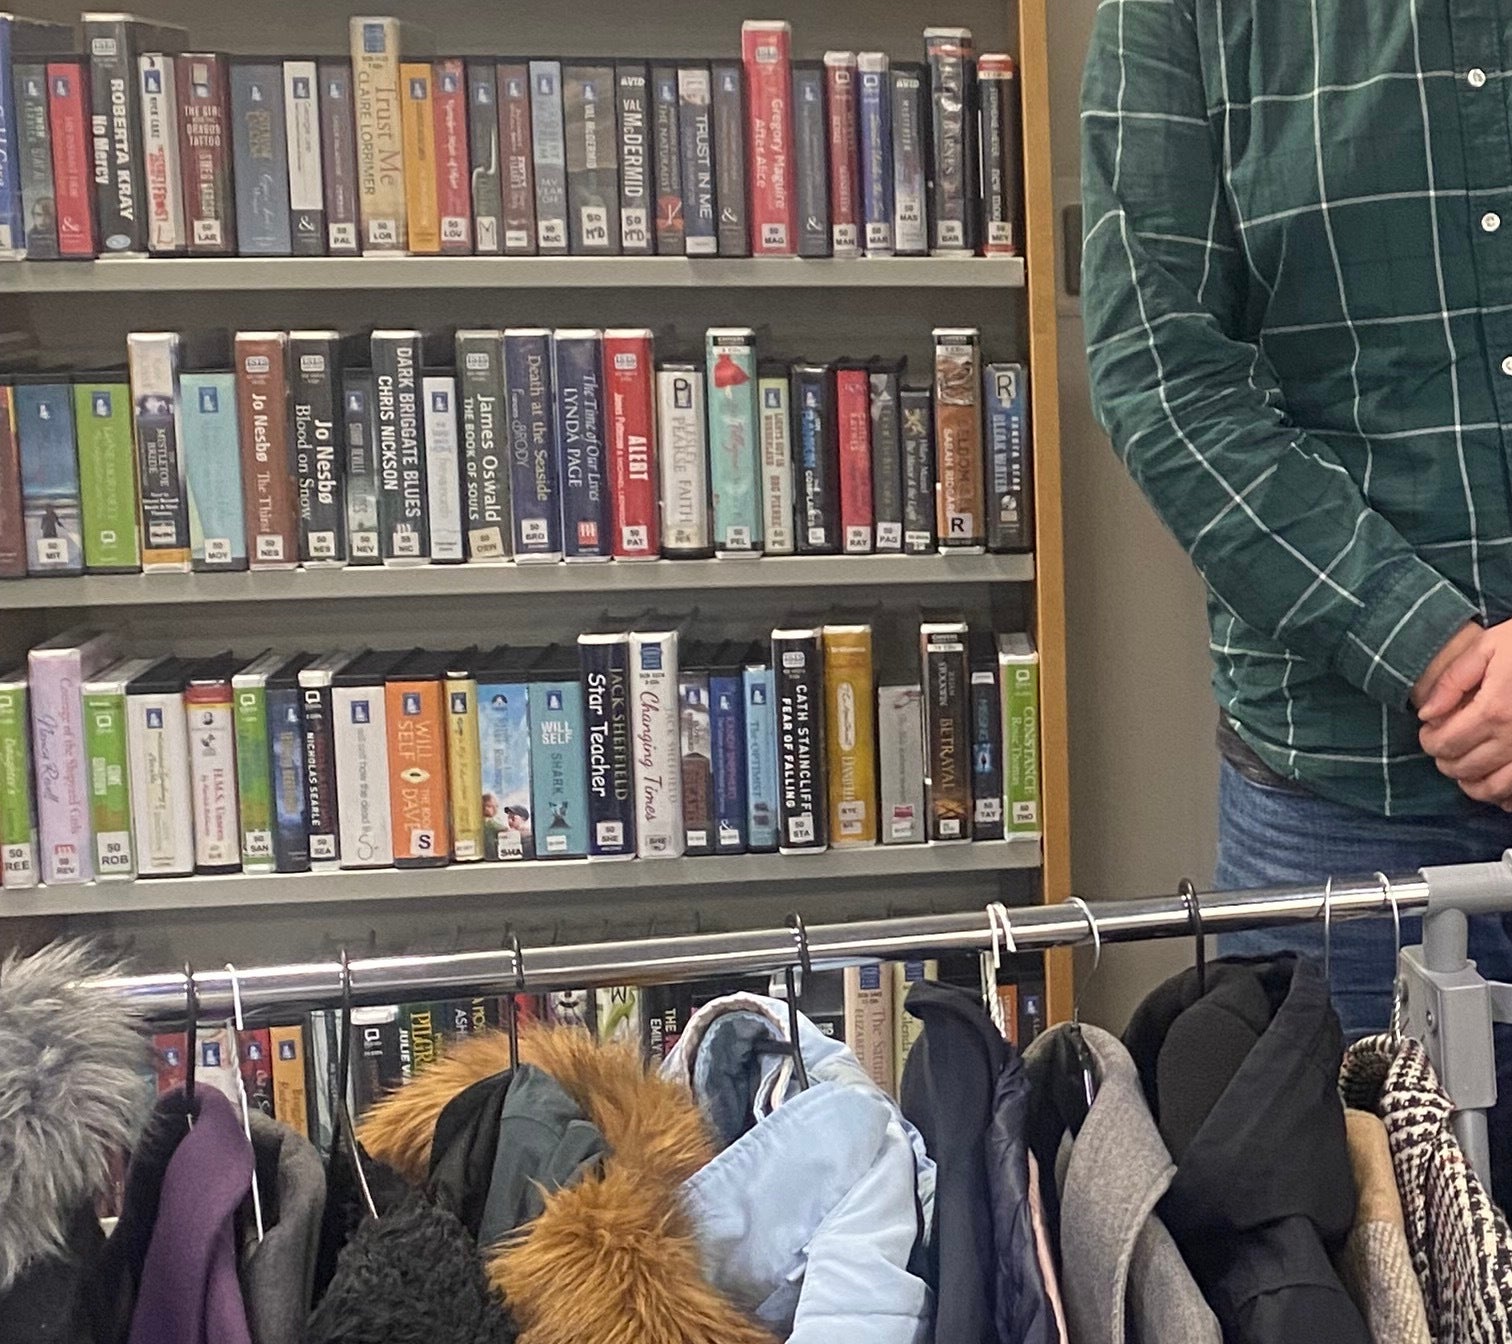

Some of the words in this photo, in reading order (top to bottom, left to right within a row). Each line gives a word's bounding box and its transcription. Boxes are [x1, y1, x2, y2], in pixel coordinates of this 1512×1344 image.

[357, 71, 372, 125] CLAIRE
[374, 82, 397, 139] Trust
[622, 98, 642, 112] VAL
[659, 104, 669, 124] THE
[91, 115, 107, 136] No
[110, 78, 130, 164] ROBERTA
[189, 135, 221, 147] TATTOO
[695, 113, 710, 167] TRUST
[771, 98, 784, 154] Gregory
[94, 137, 110, 185] Mercy
[360, 126, 377, 197] LORRIMER
[377, 149, 401, 187] Me
[622, 112, 644, 198] McDERMID
[116, 170, 134, 221] KRAY
[697, 172, 711, 189] IN
[773, 155, 786, 210] Maguire
[698, 193, 713, 219] ME
[396, 347, 414, 389] DARK
[527, 355, 545, 397] Death
[583, 373, 596, 396] The
[996, 375, 1012, 397] R
[252, 393, 267, 411] Jo
[377, 375, 394, 421] CHRIS
[463, 396, 474, 421] THE
[530, 401, 542, 418] at
[562, 388, 581, 444] LYNDA
[583, 399, 598, 431] Time
[253, 415, 269, 463] Nesbø
[295, 404, 312, 454] Blood
[314, 419, 332, 440] Jo
[399, 393, 418, 466] BRIGGATE
[476, 393, 495, 449] James
[532, 422, 546, 444] the
[992, 413, 1006, 452] BLEAK
[147, 442, 158, 474] BRIDE
[156, 427, 170, 487] MISTLETOE
[380, 425, 399, 491] NICKSON
[463, 425, 475, 458] BOOK
[511, 419, 530, 469] BRODY
[585, 445, 600, 471] Our
[627, 435, 649, 481] ALERT
[671, 416, 687, 472] PEARSE
[942, 428, 954, 467] SARAH
[257, 470, 271, 493] The
[298, 455, 308, 474] on
[316, 446, 337, 505] Nesbø
[466, 462, 477, 478] OF
[534, 449, 549, 503] Seaside
[566, 447, 583, 488] PAGE
[994, 453, 1008, 493] WATER
[299, 478, 315, 521] Snow
[403, 472, 421, 518] BLUES
[467, 482, 479, 522] SOULS
[481, 455, 501, 523] Oswald
[587, 472, 600, 502] Lives
[678, 479, 693, 524] FAITH
[626, 537, 644, 547] PAT
[849, 537, 868, 547] RAY
[951, 517, 965, 533] R
[588, 672, 606, 715] Star
[608, 667, 625, 709] JACK
[795, 684, 808, 720] CATH
[541, 720, 573, 734] WILL
[639, 691, 660, 768] Changing
[781, 697, 793, 732] FEAR
[65, 739, 76, 757] the
[397, 719, 415, 760] SELF
[415, 719, 432, 757] WILL
[541, 733, 573, 745] SELF
[611, 713, 629, 802] SHEFFIELD
[783, 734, 794, 751] OF
[939, 717, 956, 790] BETRAYAL
[1022, 706, 1036, 795] CONSTANCE
[306, 732, 321, 785] NICHOLAS
[551, 752, 565, 795] SHARK
[590, 720, 611, 798] Teacher
[422, 788, 430, 803] THE
[643, 775, 663, 823] Times
[784, 755, 796, 809] FALLING
[308, 786, 321, 827] SEARLE
[979, 809, 997, 819] TAY
[101, 855, 129, 865] ROB
[250, 843, 270, 853] SAN
[418, 834, 431, 849] S
[4, 861, 31, 872] REE
[650, 1017, 663, 1053] EMILY
[664, 1007, 677, 1032] THE
[871, 1009, 886, 1036] The
[399, 1027, 410, 1063] JULIE
